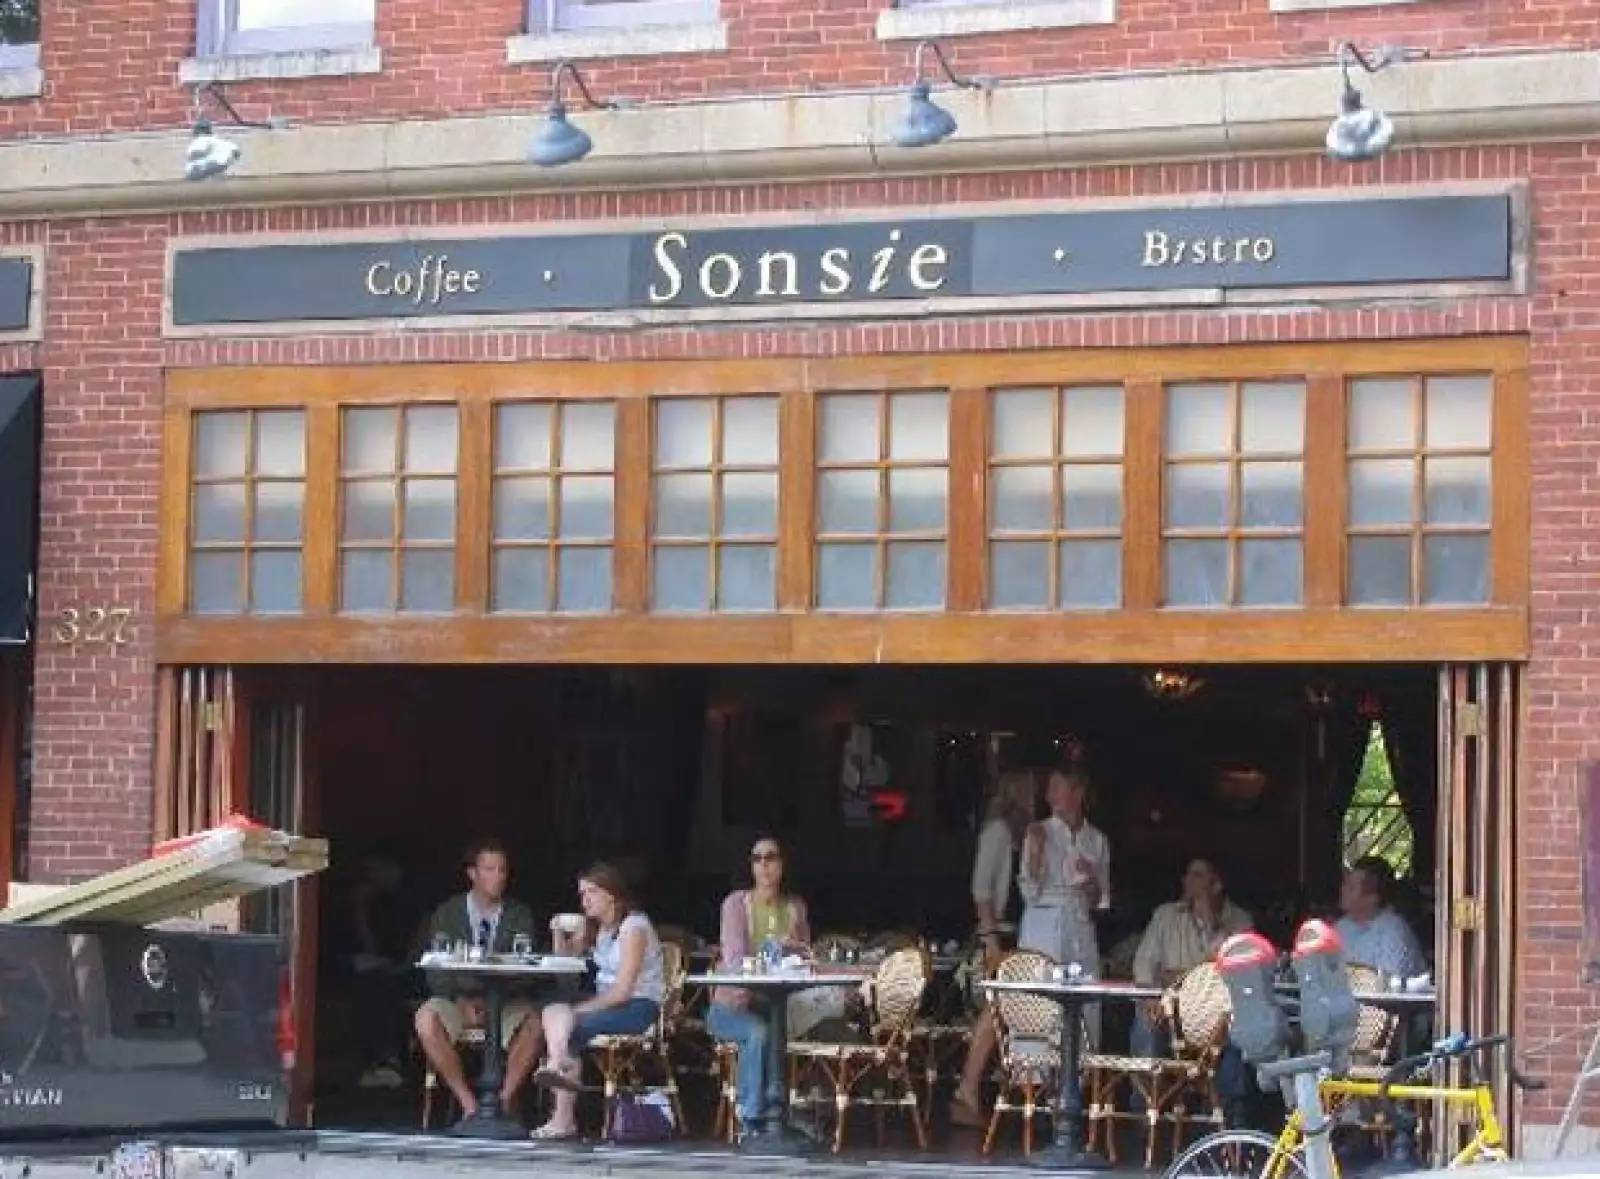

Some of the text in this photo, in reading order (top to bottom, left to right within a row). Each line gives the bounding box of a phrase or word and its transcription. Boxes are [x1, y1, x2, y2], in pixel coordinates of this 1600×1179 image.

[365, 229, 1275, 306] Coffee Sonsie Bistro
[56, 608, 131, 644] 327
